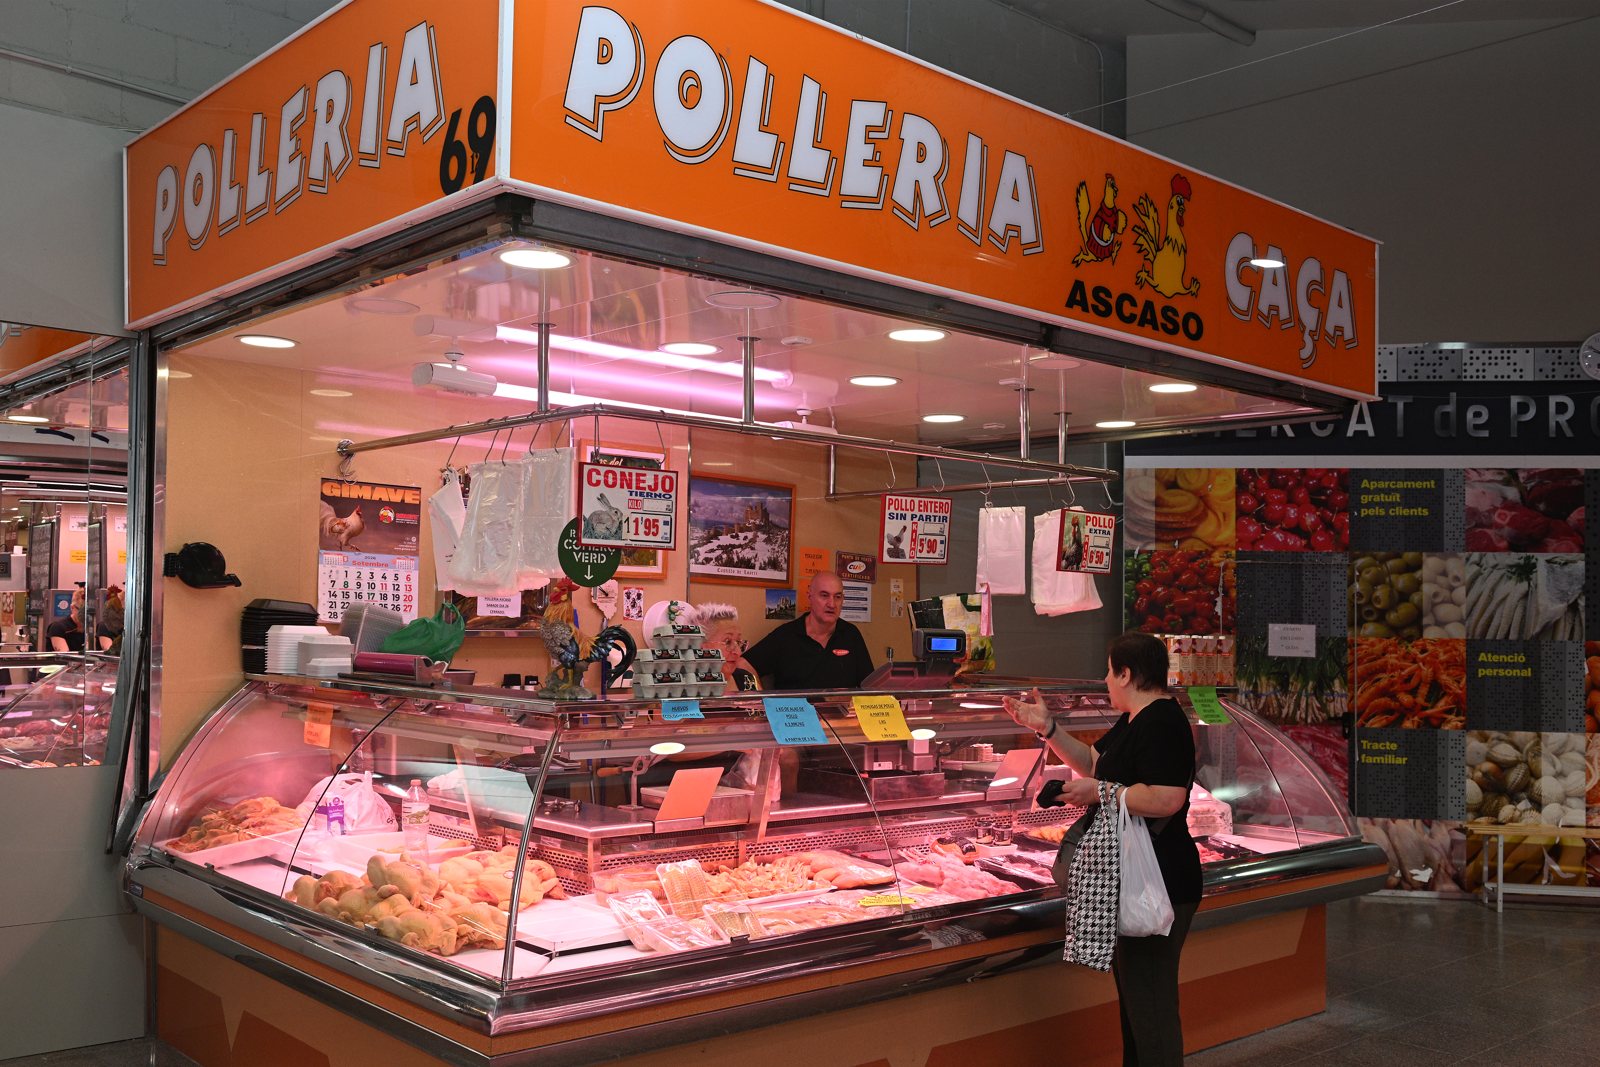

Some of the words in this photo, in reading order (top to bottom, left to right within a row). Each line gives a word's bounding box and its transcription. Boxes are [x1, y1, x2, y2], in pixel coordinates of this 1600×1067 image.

[563, 6, 1044, 256] POLLERIA
[153, 20, 446, 266] POLLERIA
[439, 95, 497, 196] 69
[1224, 231, 1358, 369] CAÇA
[1065, 279, 1204, 341] ASCASO
[1434, 392, 1490, 437] de
[586, 468, 674, 493] CONEJO
[1360, 480, 1436, 490] Aparcament
[322, 482, 420, 504] GIMAVE
[628, 490, 672, 499] TIERNO
[628, 500, 642, 509] KILO
[888, 498, 916, 512] POLLO
[918, 500, 950, 514] ENTERO
[1360, 507, 1385, 517] pels
[1389, 506, 1429, 516] clients
[888, 512, 906, 520] SIN
[910, 514, 948, 523] PARTIR
[1086, 515, 1113, 529] POLLO
[910, 523, 918, 557] KILO
[572, 552, 606, 564] VERD
[344, 570, 348, 578] 1
[404, 584, 412, 592] 13
[367, 592, 375, 600] 17
[403, 594, 413, 602] 20
[1478, 653, 1526, 662] Atenció
[1478, 668, 1532, 678] personal
[1360, 740, 1398, 750] Tracte
[1360, 754, 1408, 764] familiar
